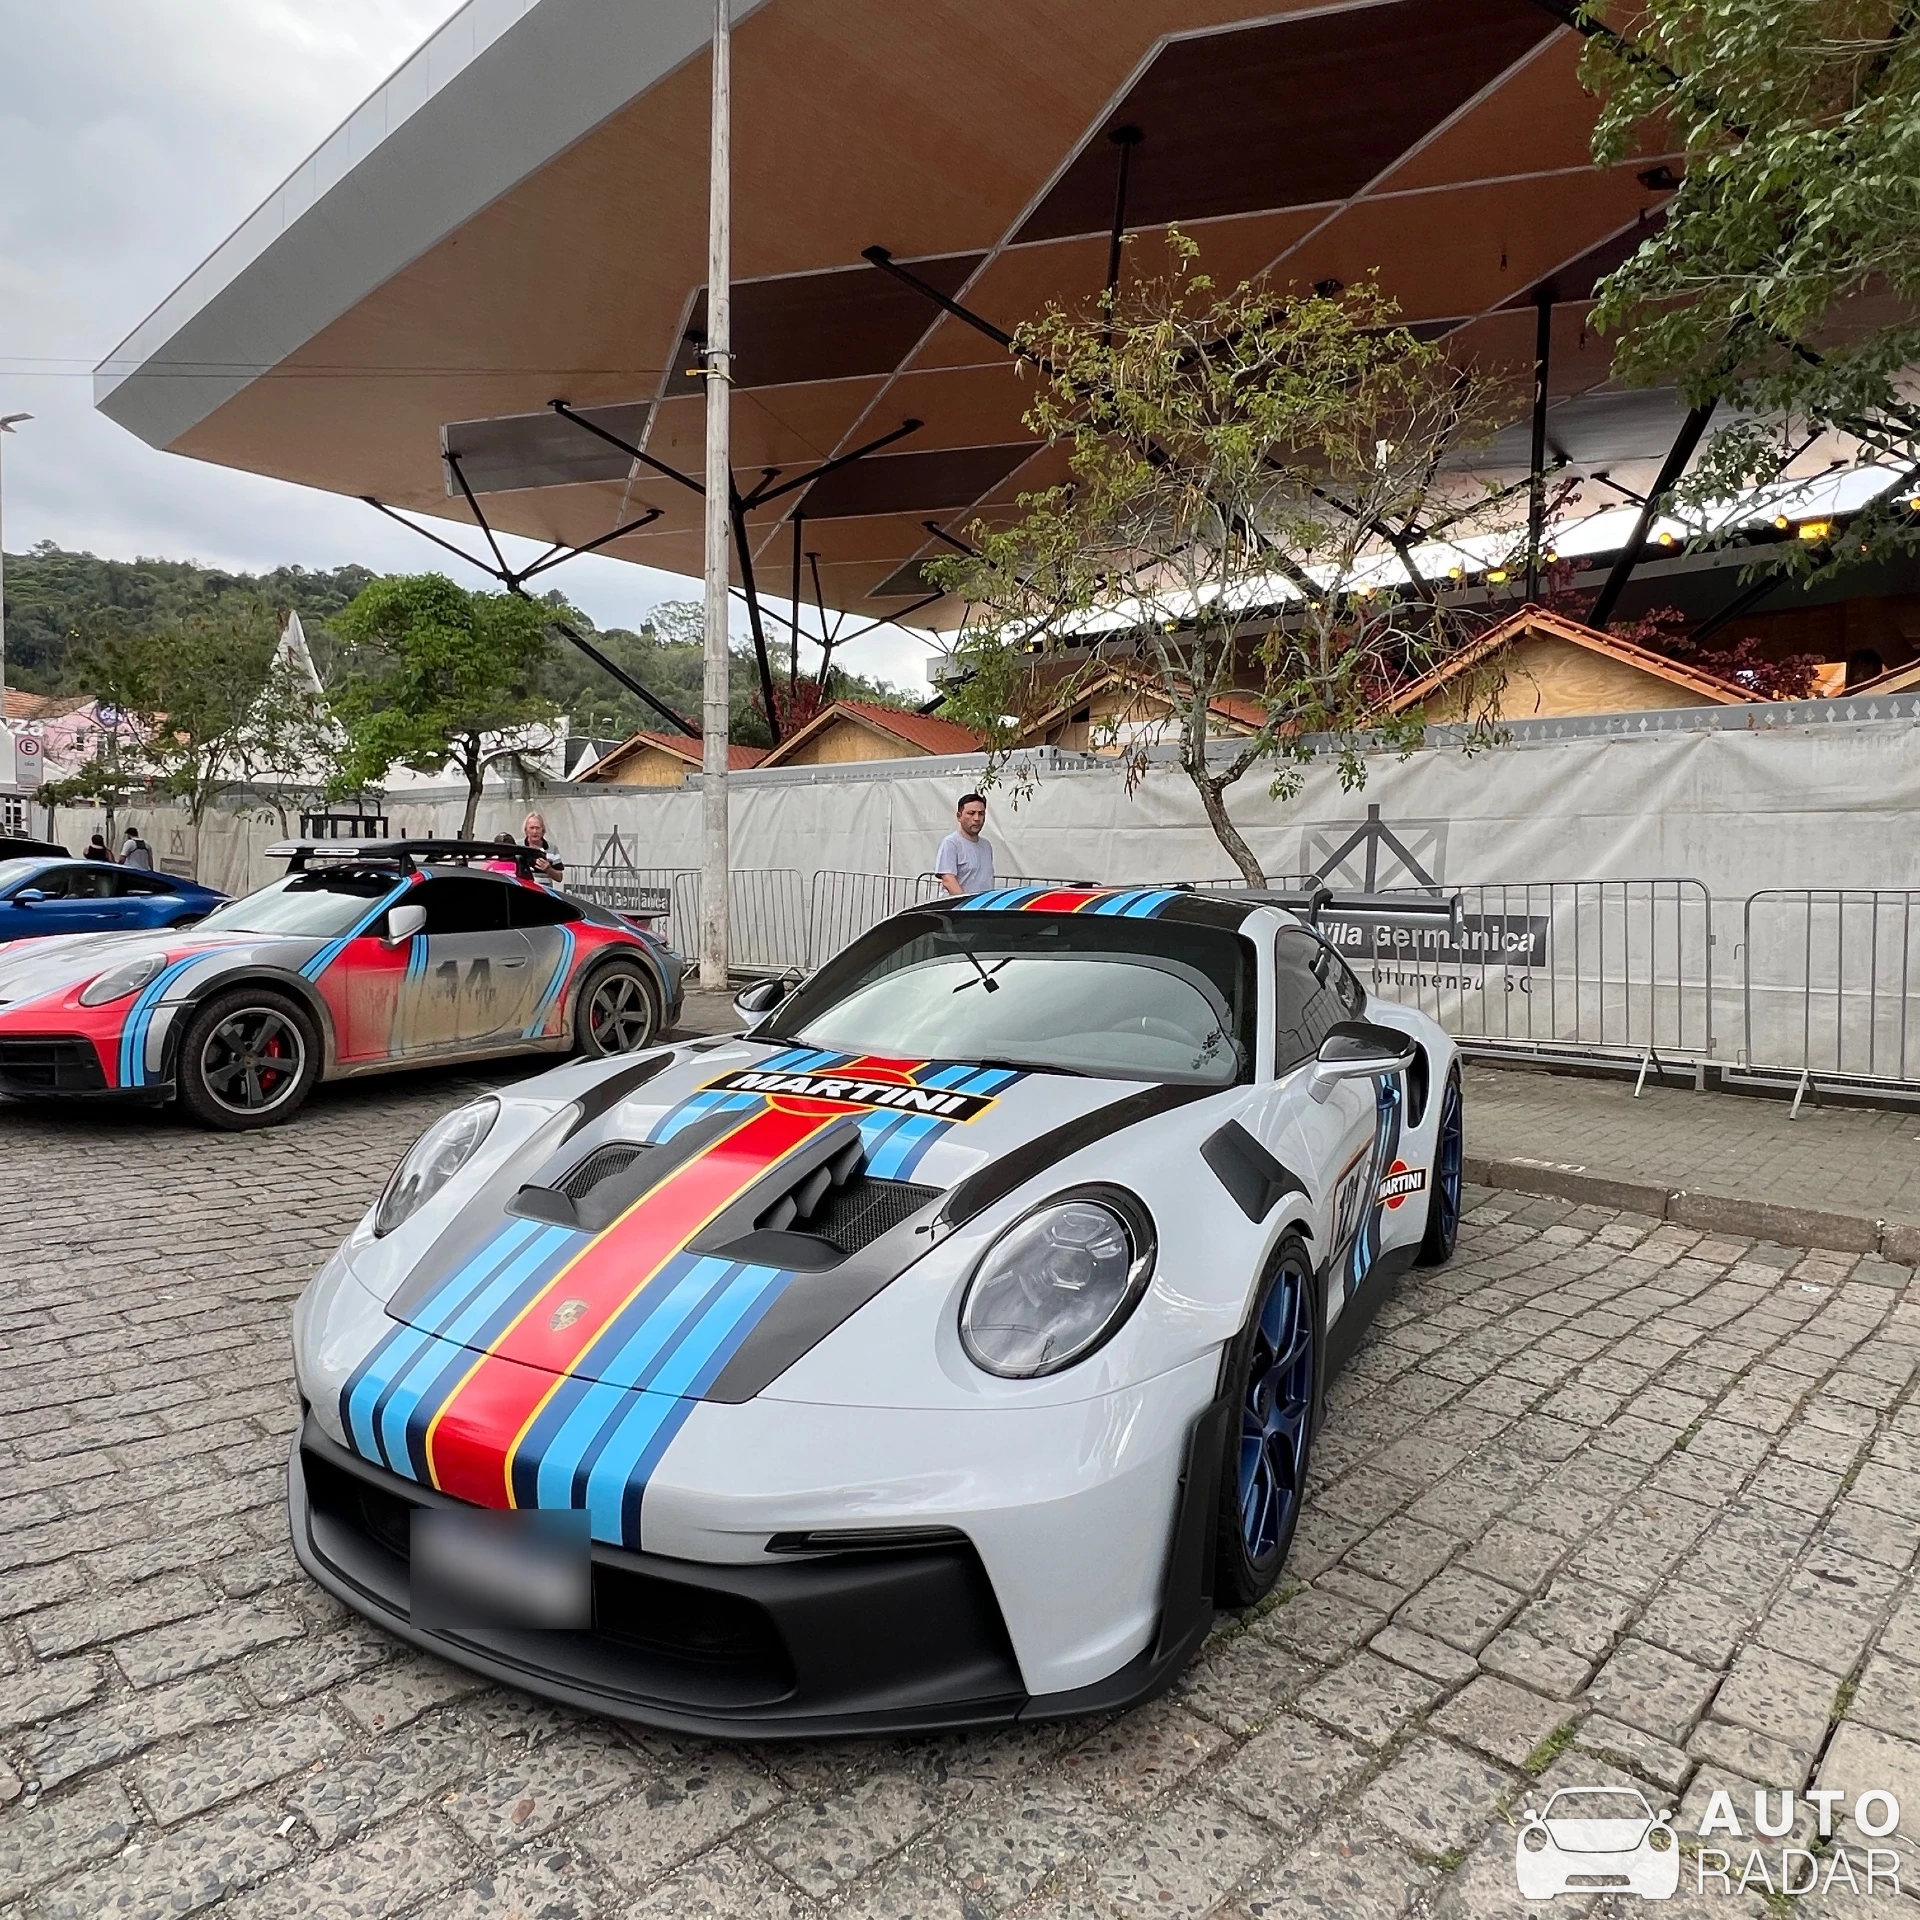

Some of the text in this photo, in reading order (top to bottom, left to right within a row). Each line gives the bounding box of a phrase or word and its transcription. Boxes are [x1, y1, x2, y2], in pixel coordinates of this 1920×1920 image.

[25, 742, 33, 752] E
[1372, 967, 1533, 994] Blumenau SC
[726, 1073, 968, 1115] MARTINI
[1379, 1171, 1422, 1200] MARTINI
